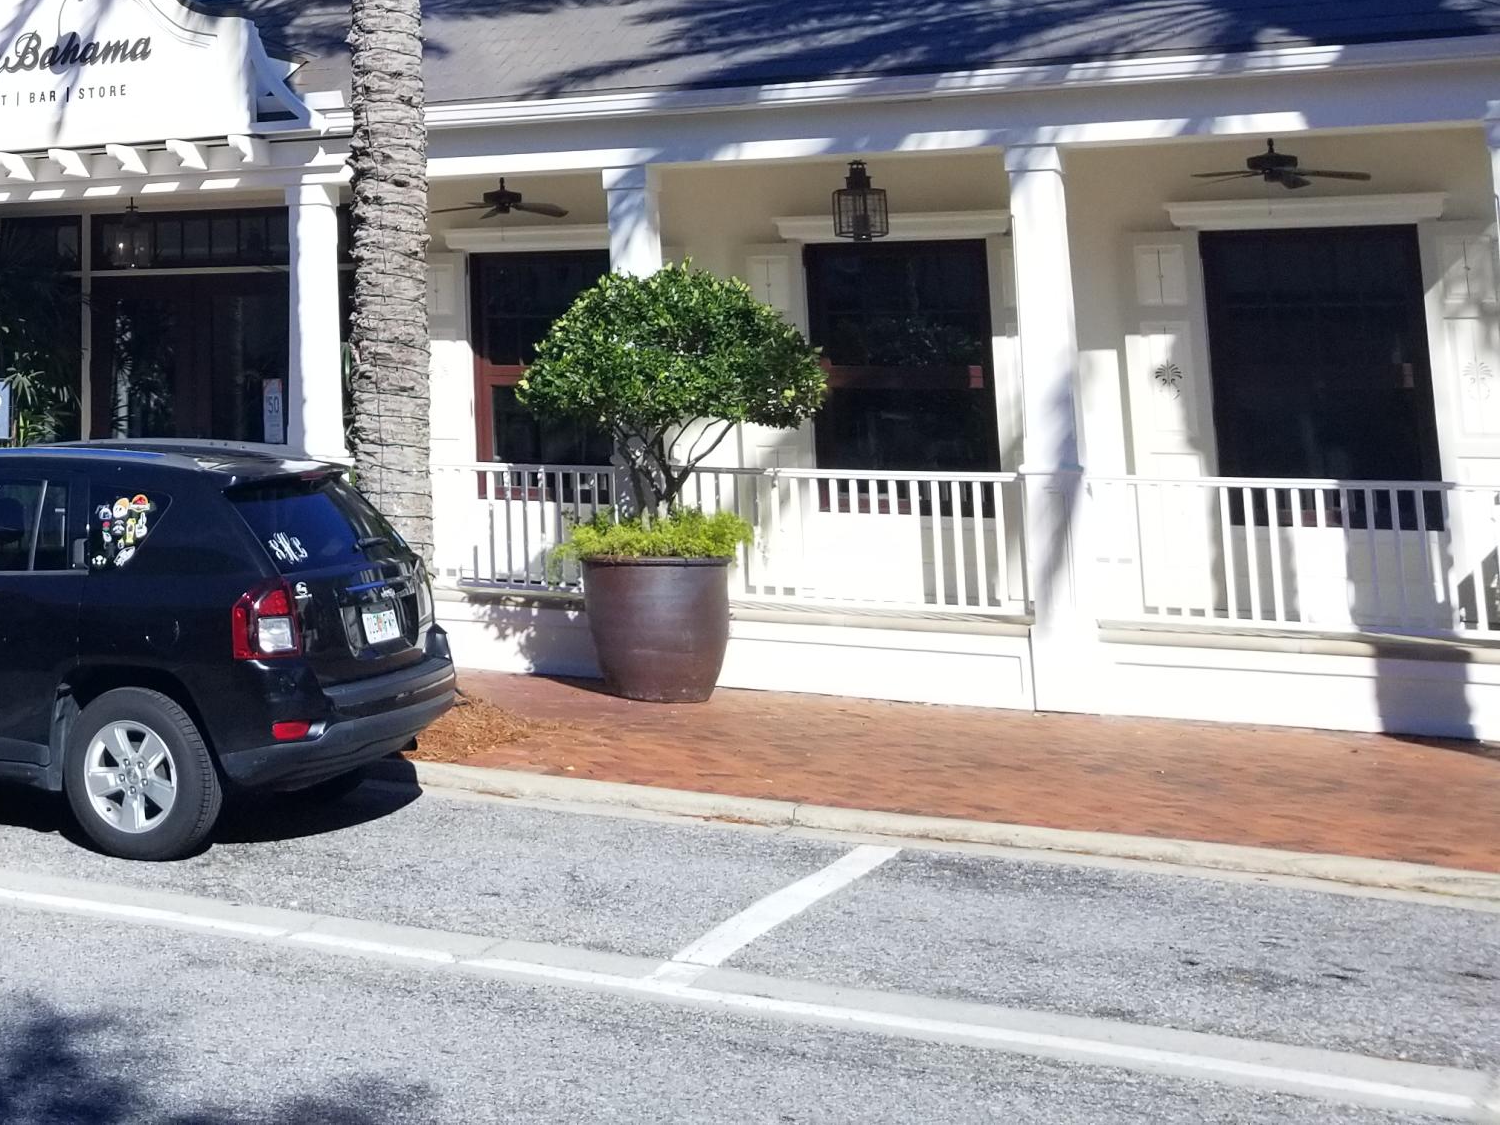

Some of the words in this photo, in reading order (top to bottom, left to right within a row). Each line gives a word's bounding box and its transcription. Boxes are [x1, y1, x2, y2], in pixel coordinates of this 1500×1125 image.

[9, 30, 152, 73] Bahama
[29, 90, 56, 103] BAR
[78, 84, 126, 100] STORE
